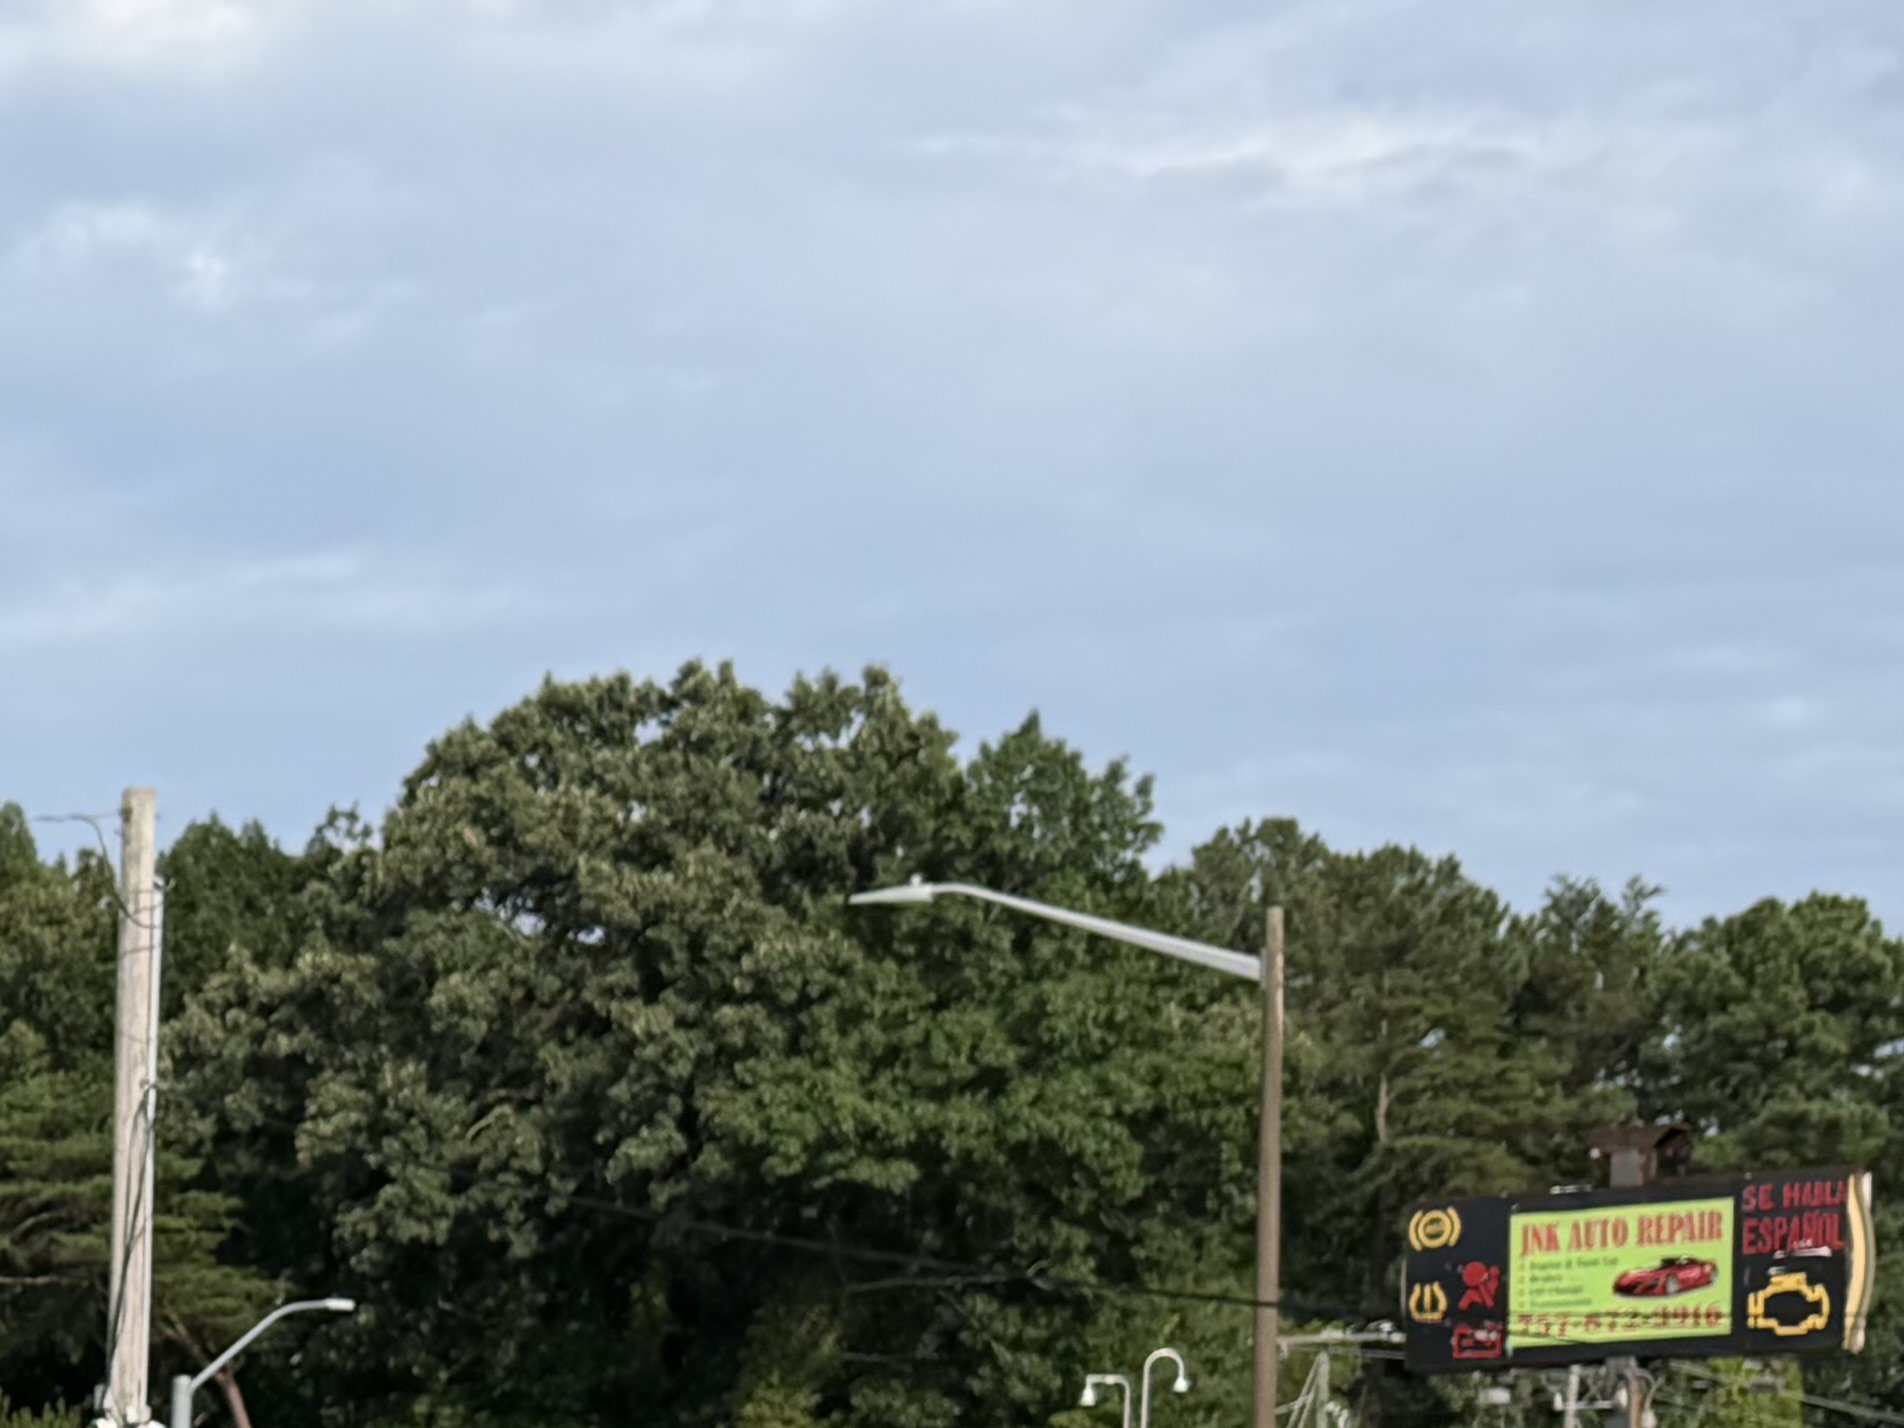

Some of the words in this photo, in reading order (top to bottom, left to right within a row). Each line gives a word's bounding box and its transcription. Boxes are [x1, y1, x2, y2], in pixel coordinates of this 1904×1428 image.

[1742, 1184, 1775, 1212] SE
[1569, 1217, 1630, 1252] AUTO
[1636, 1208, 1723, 1248] REPAIR
